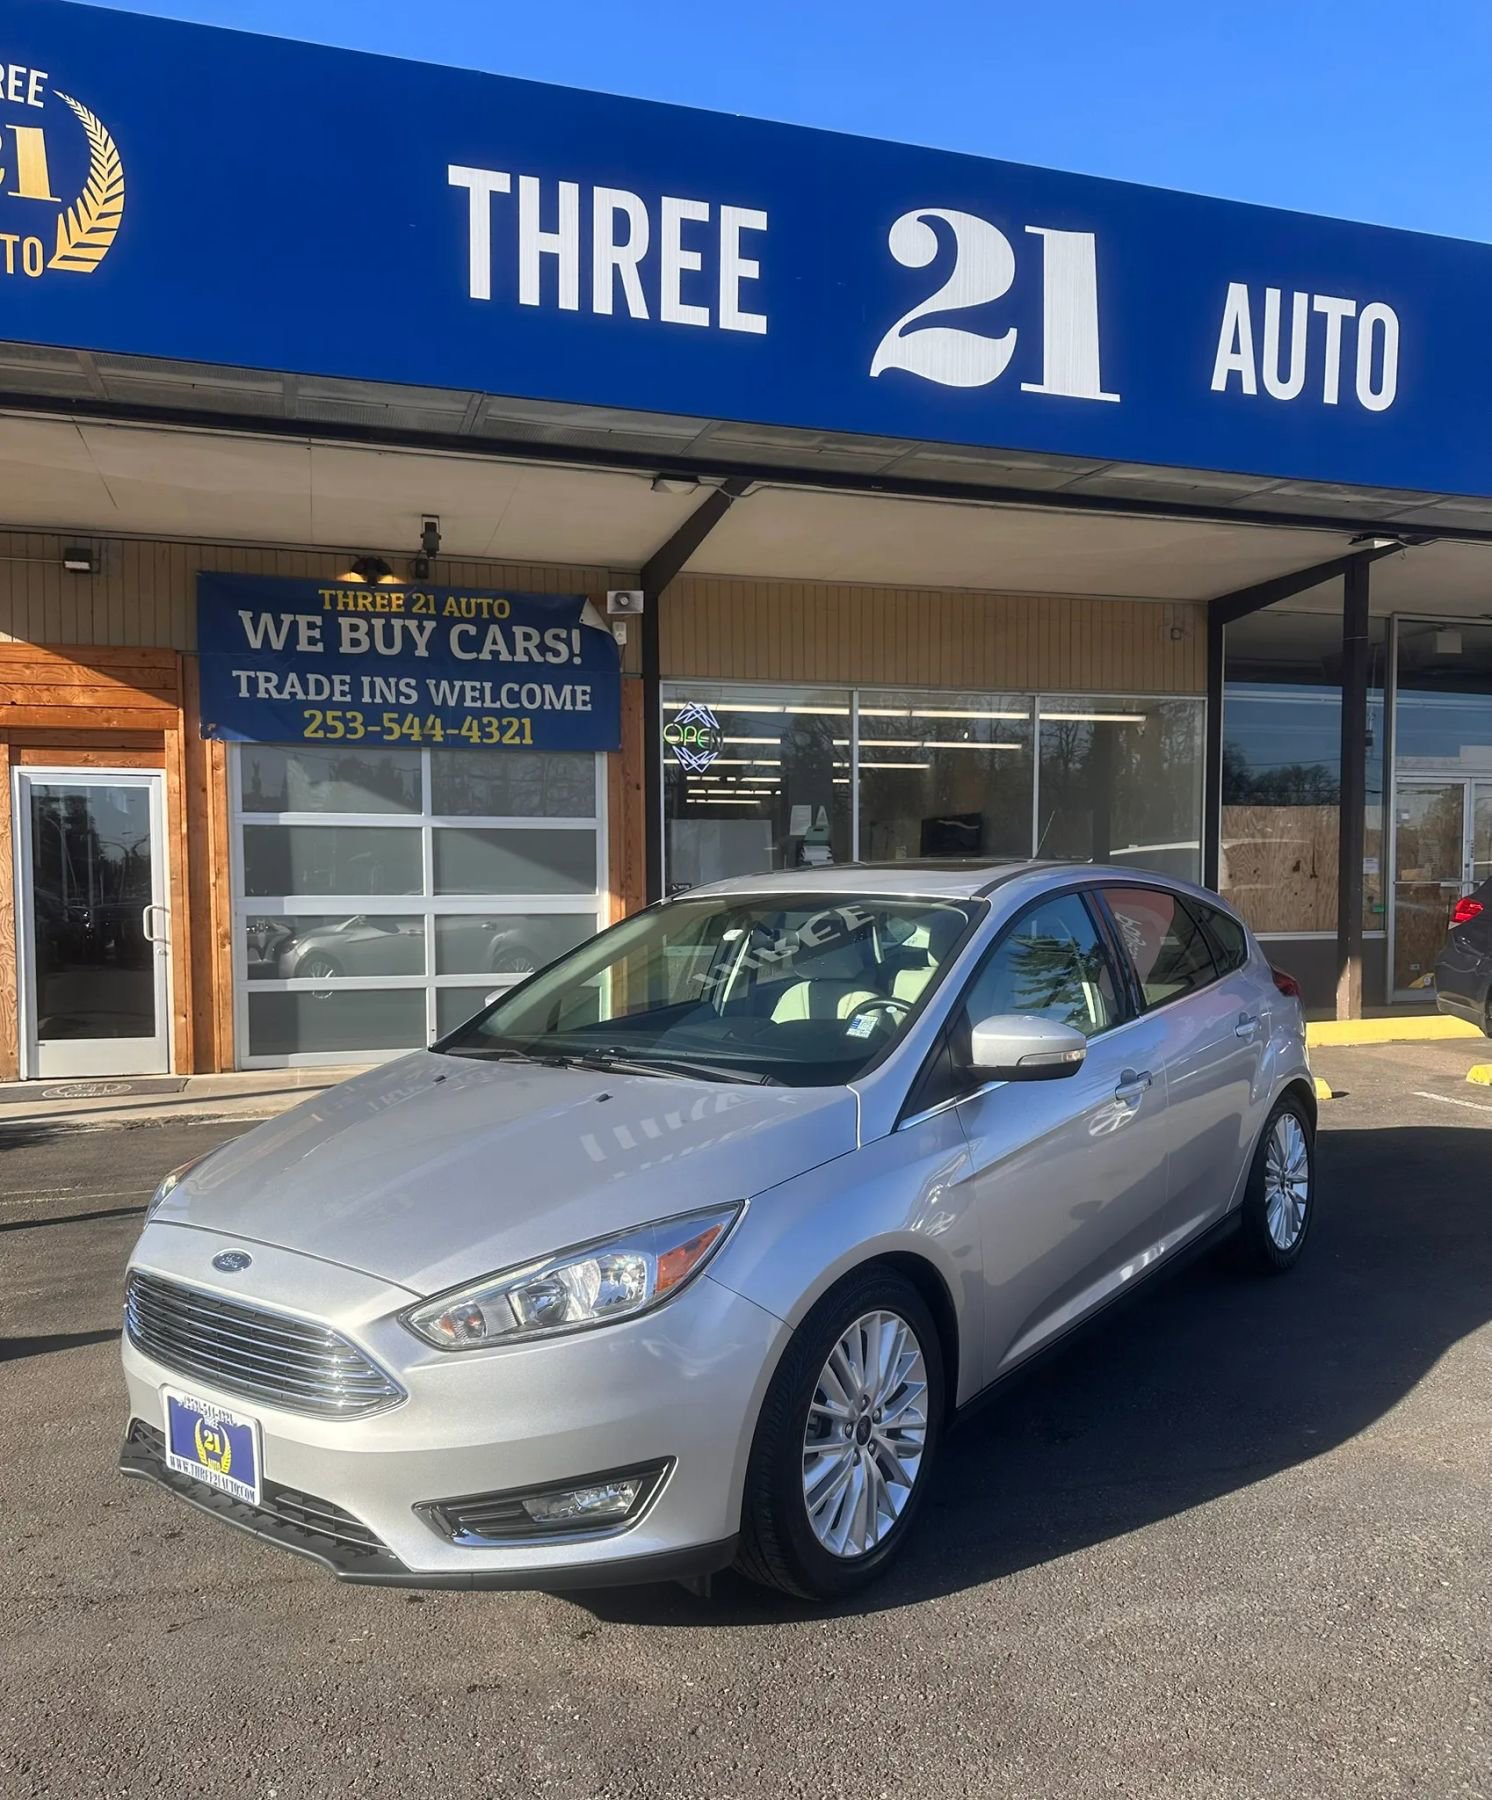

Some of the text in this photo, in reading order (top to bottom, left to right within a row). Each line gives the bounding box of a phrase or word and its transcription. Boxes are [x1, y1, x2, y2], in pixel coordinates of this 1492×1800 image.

[447, 164, 1400, 412] THREE 21 AUTO
[318, 588, 511, 619] THREE 21 AUTO
[238, 610, 582, 665] WE BUY CARS!
[231, 670, 592, 711] TRADE INS WELCOME
[303, 709, 534, 745] 253-544-4321
[203, 1429, 223, 1455] 21
